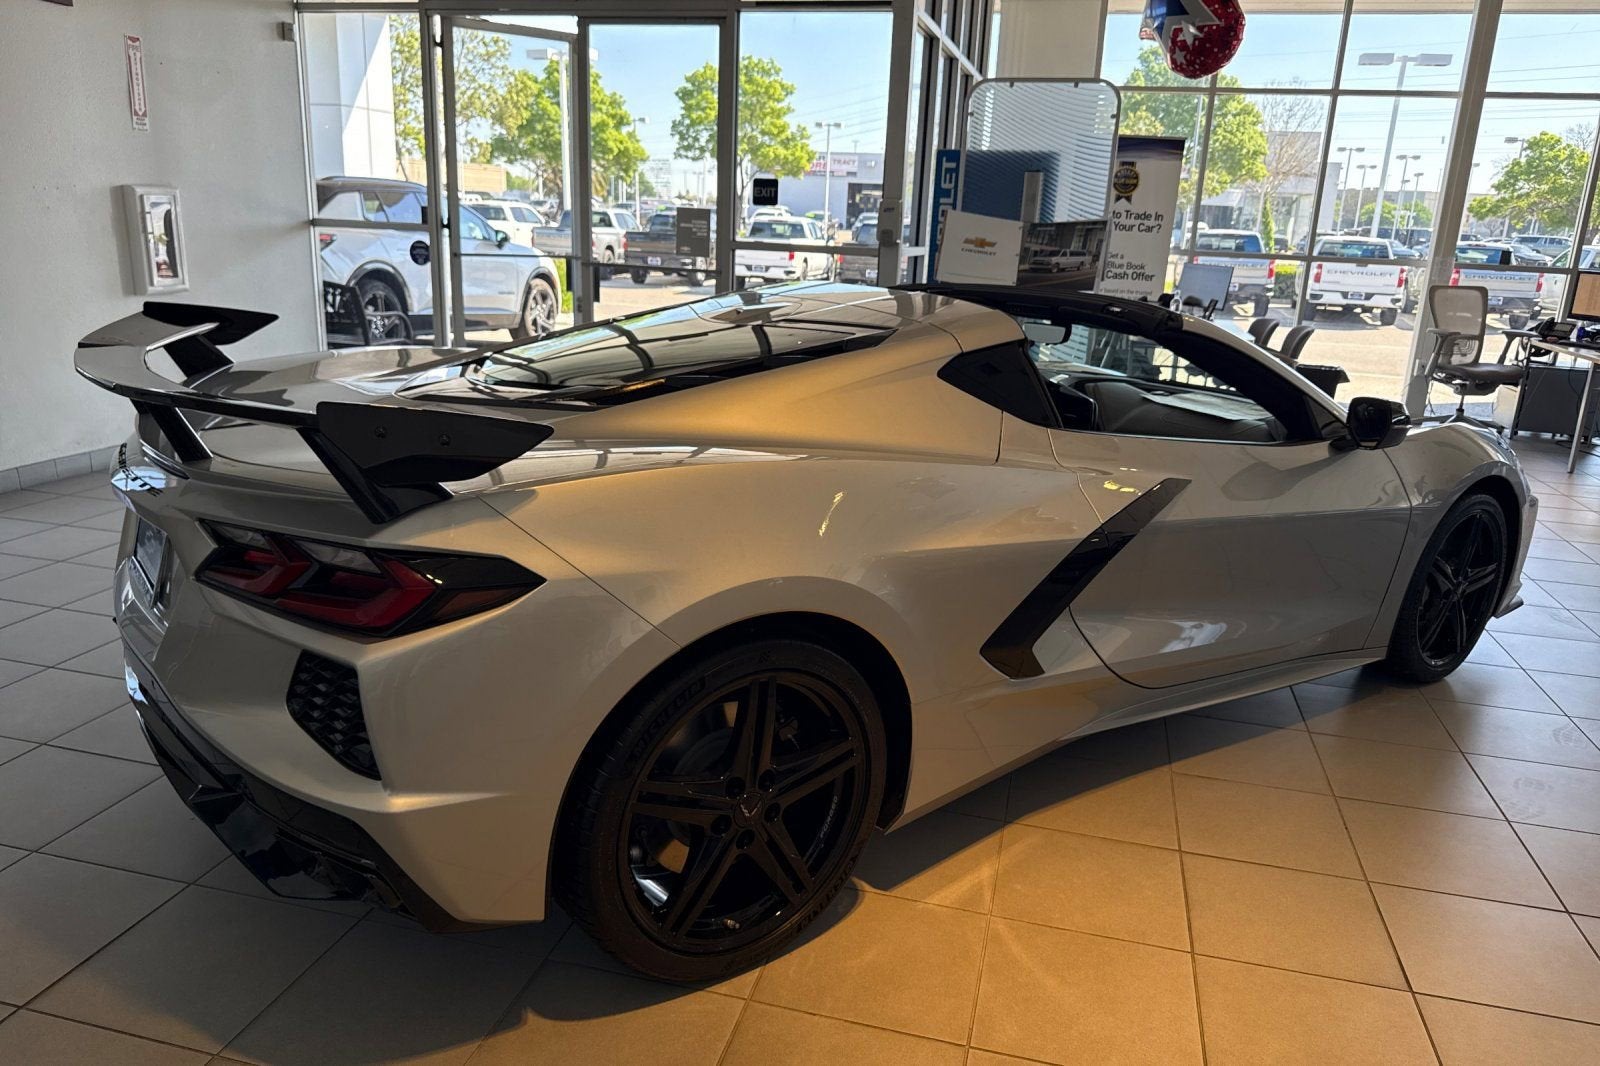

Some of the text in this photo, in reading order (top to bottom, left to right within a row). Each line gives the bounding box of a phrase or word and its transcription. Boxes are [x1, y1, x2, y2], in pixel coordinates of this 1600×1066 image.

[832, 158, 857, 167] TRACY
[753, 187, 777, 198] EXIT
[1112, 210, 1164, 222] to Trade In
[1113, 222, 1162, 234] Your Car?
[1126, 262, 1145, 271] Book
[1105, 270, 1156, 282] Cash Offer
[1326, 268, 1395, 278] CHEVROLET
[1463, 274, 1535, 282] CHEVROLET
